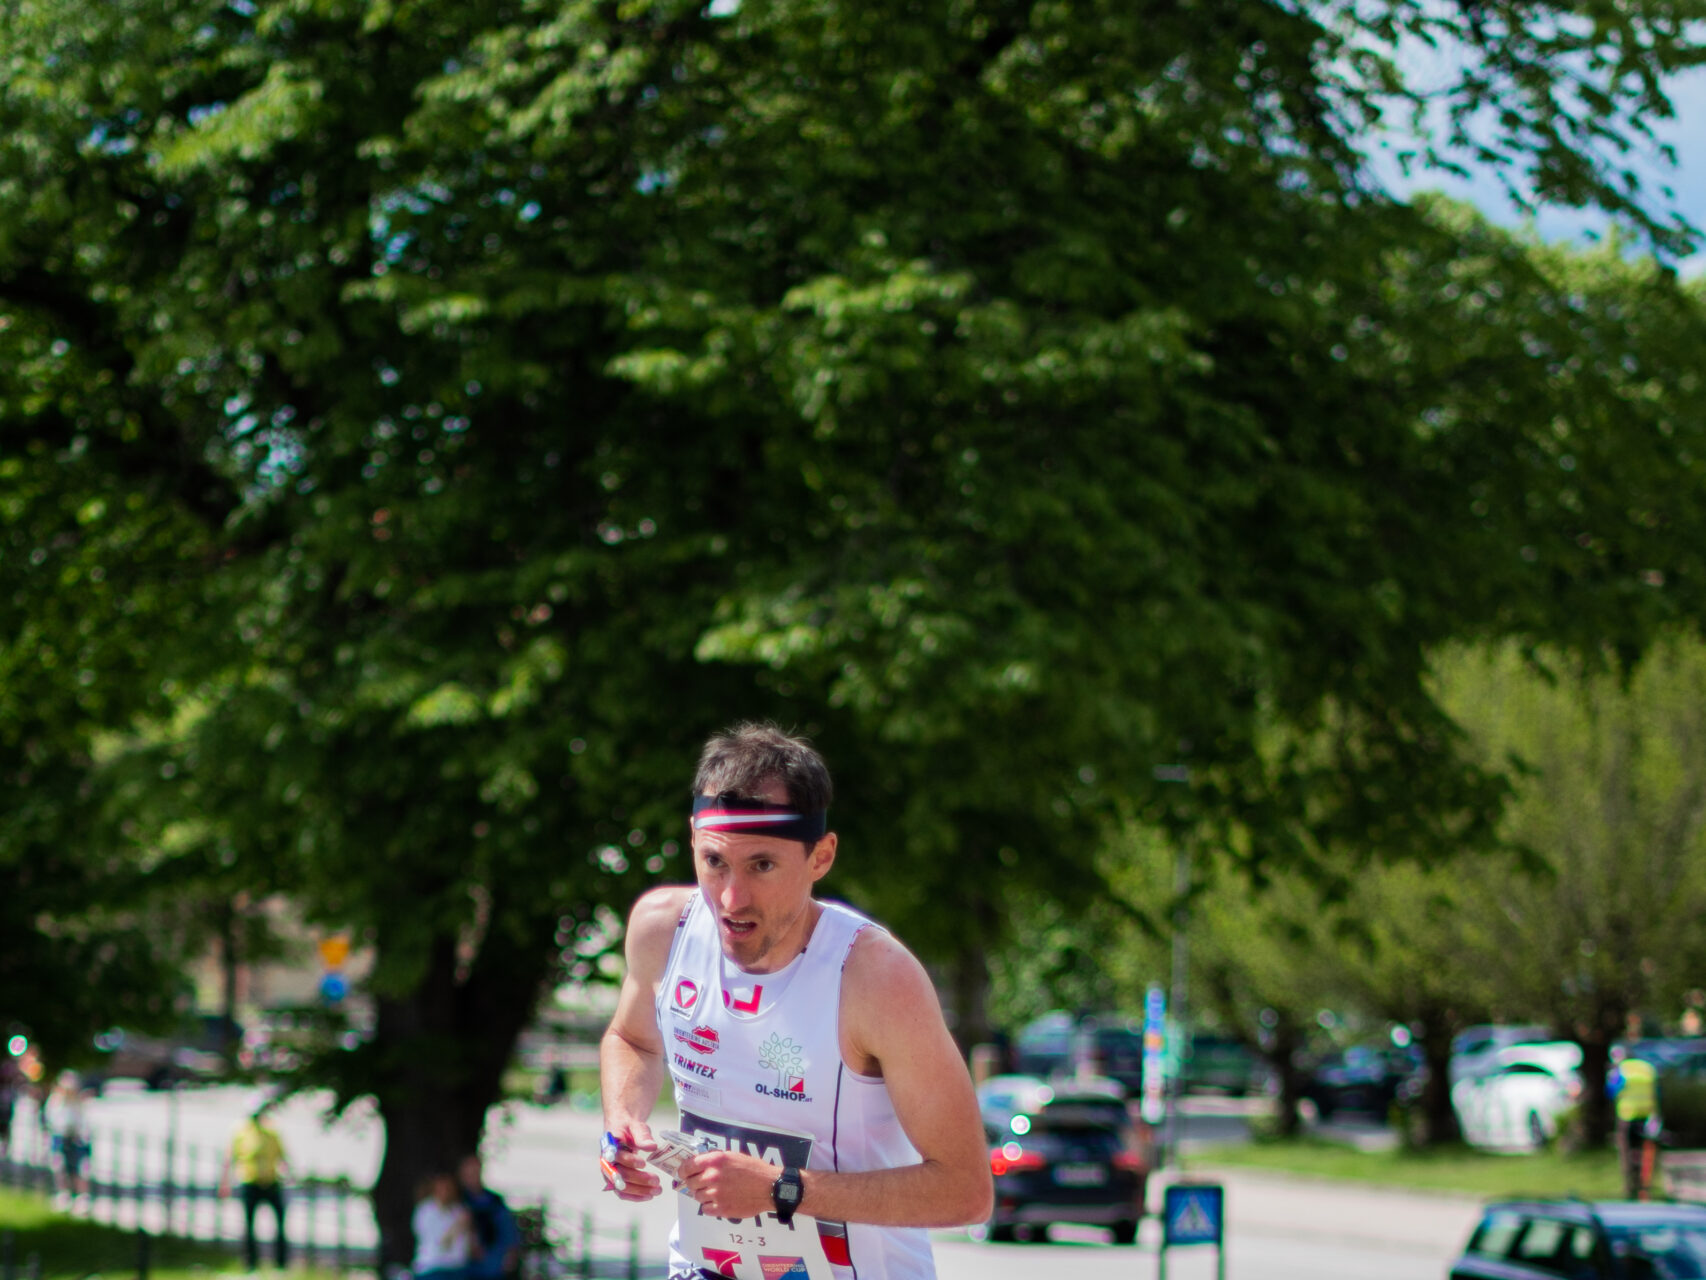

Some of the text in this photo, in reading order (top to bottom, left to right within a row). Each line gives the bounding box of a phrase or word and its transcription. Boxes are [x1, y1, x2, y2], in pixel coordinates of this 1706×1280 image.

[674, 1053, 717, 1079] TRIMTEX
[729, 1233, 744, 1245] 12
[758, 1236, 767, 1247] 3
